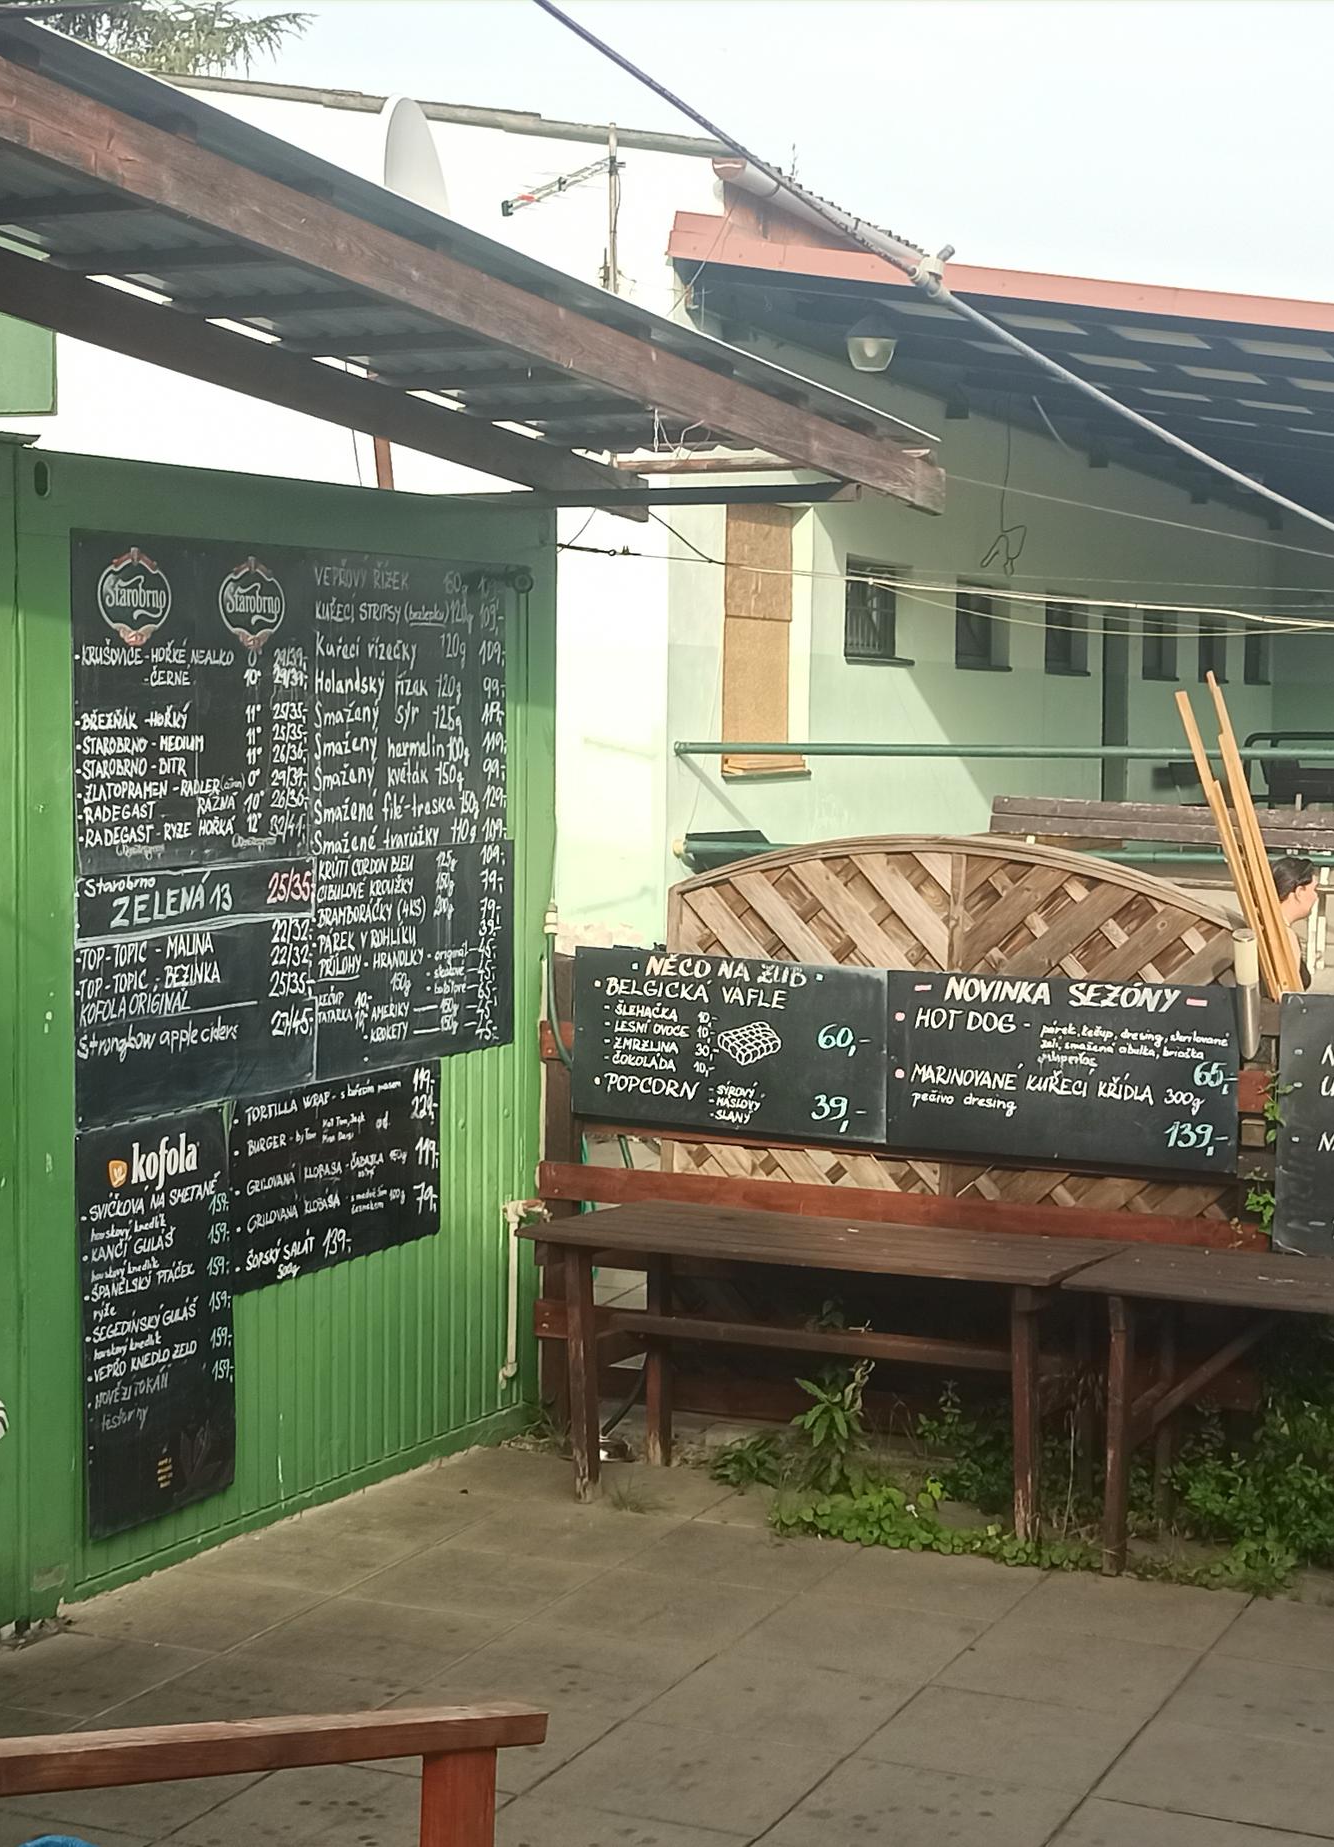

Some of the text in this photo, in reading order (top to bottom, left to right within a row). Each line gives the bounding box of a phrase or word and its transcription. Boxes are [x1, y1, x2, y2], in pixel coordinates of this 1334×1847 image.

[103, 574, 166, 619] Starobrno
[225, 581, 280, 625] Starobrno
[315, 666, 385, 700] Holandský
[315, 701, 379, 730] Smažený
[83, 735, 204, 755] STAROBRNO MEDIUM
[315, 727, 377, 760] Smažený
[83, 757, 187, 779] STAROBRNO BITR
[313, 757, 377, 791] Smažený
[84, 779, 220, 804] ZLATOPRAMEN RADLER
[84, 801, 156, 825] RADEGAST
[85, 824, 154, 847] RADEGAST
[84, 876, 156, 897] Starobrno
[111, 871, 232, 928] ZELENÁ 13
[167, 932, 214, 958] MALINA
[318, 922, 416, 953] PÁREK V ROHLÍKU
[373, 949, 424, 970] HRANOLKY
[645, 955, 807, 987] NĚCO NA ZUB
[605, 977, 788, 1010] BELGICKÁ VAFLE
[944, 976, 1182, 1012] NOVINKA SEZÓNY
[80, 998, 126, 1027] KOFOLA
[614, 999, 678, 1022] ŠLEHAČKA
[915, 1008, 1016, 1033] HOT DOG
[77, 1021, 198, 1062] Strongbow apple
[614, 1020, 651, 1034] LESNÍ
[653, 1023, 690, 1037] OVOCE
[614, 1037, 679, 1054] ZMRZLINA
[612, 1053, 676, 1072] ČOKOLÁDA
[604, 1072, 700, 1100] POPCORN
[910, 1062, 1205, 1115] MARINOVANÉ KUŘECÍ KŘÍDLA 300g
[245, 1099, 298, 1126] TORTILLA
[912, 1092, 1017, 1116] pečivo dresing
[248, 1133, 287, 1157] BURGER
[131, 1133, 197, 1190] kofola
[150, 1193, 166, 1210] NA
[131, 1349, 170, 1372] KNEDLO
